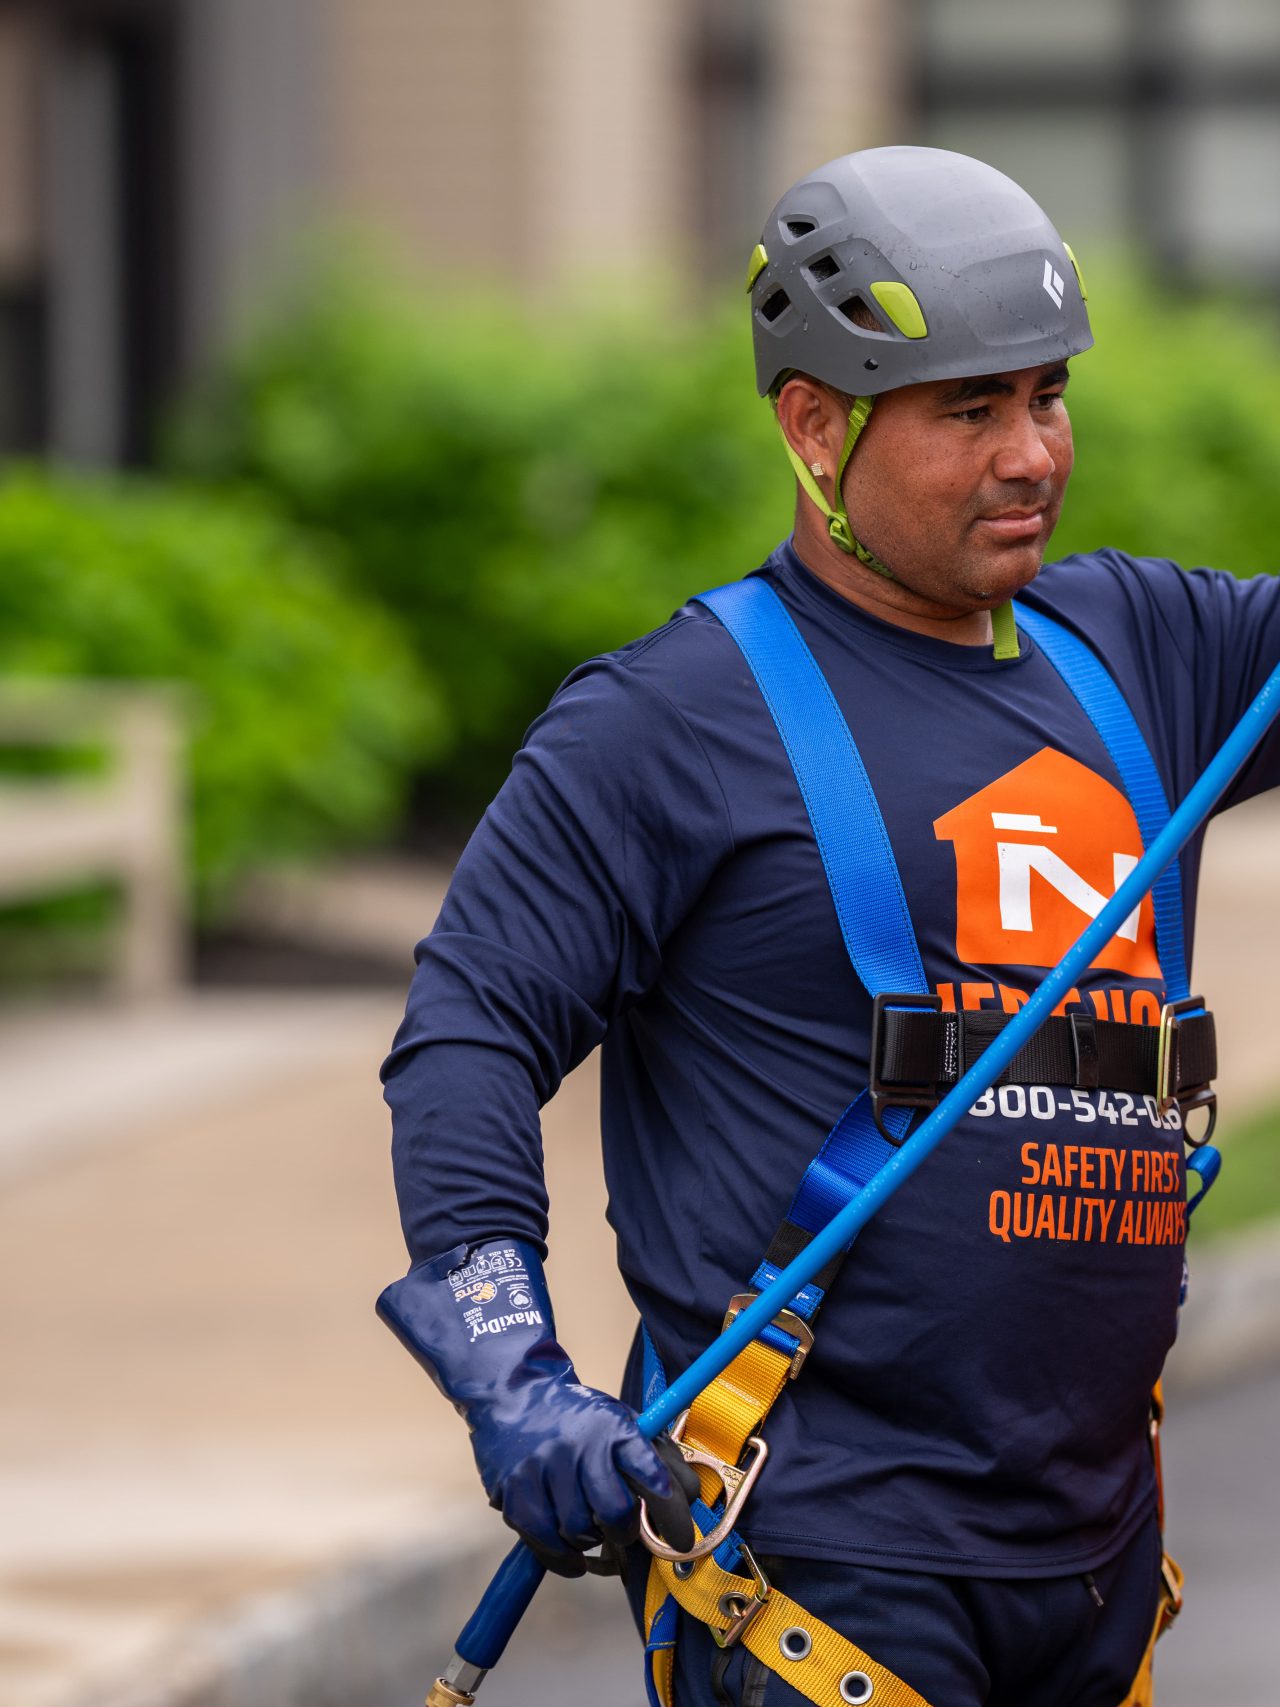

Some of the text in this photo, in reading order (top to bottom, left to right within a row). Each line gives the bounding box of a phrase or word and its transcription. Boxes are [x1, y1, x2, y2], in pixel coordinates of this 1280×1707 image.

[1021, 1142, 1180, 1194] SAFETY FIRST
[989, 1190, 1116, 1242] QUALITY
[473, 1311, 543, 1337] MaxiDry
